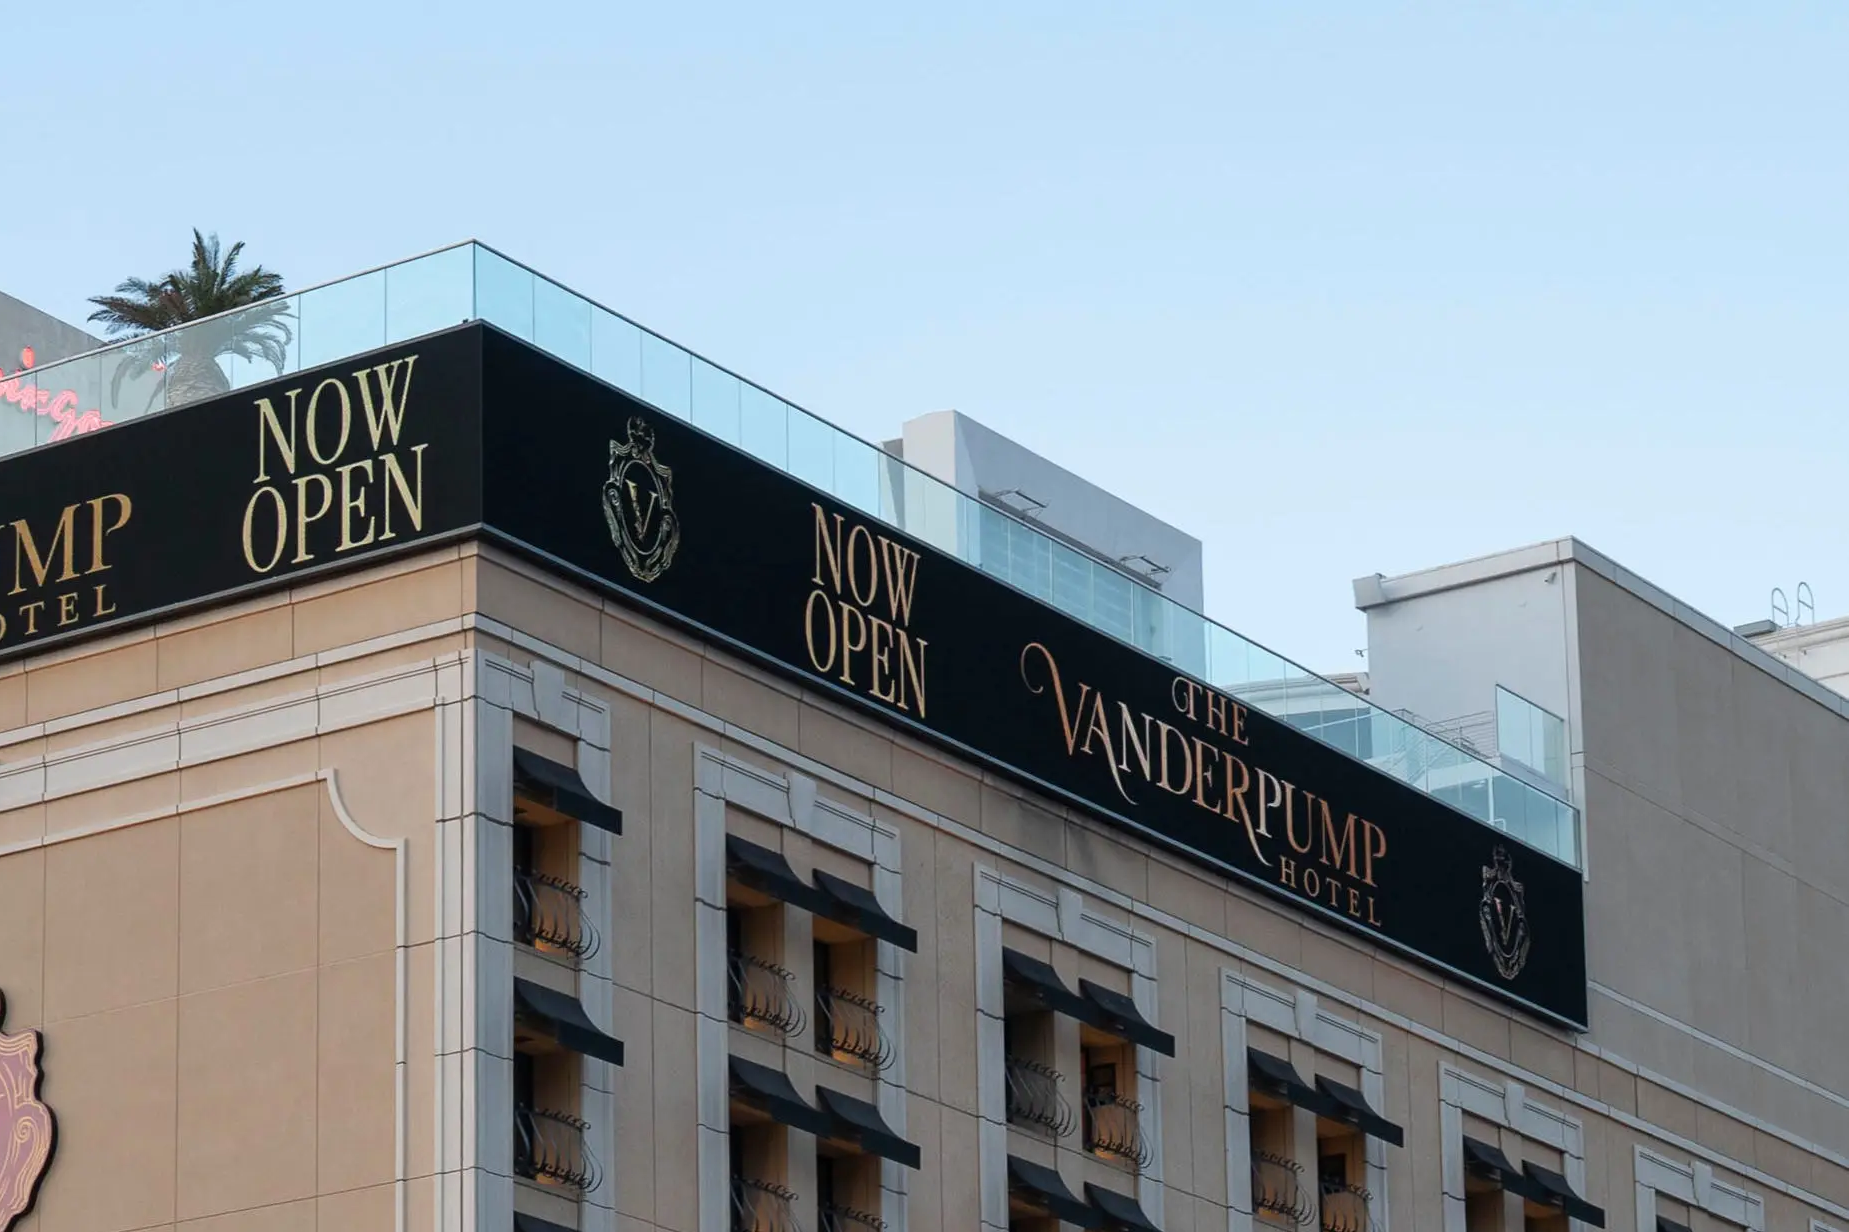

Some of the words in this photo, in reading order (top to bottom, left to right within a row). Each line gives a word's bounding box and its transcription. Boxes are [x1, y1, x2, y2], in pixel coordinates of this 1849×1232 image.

[253, 354, 419, 483] NOW
[242, 443, 429, 574] OPEN
[811, 501, 921, 628] NOW
[803, 595, 928, 719] OPEN
[1171, 675, 1249, 747] THE
[1020, 641, 1388, 888] VANDERPUMP
[1279, 856, 1383, 928] HOTEL
